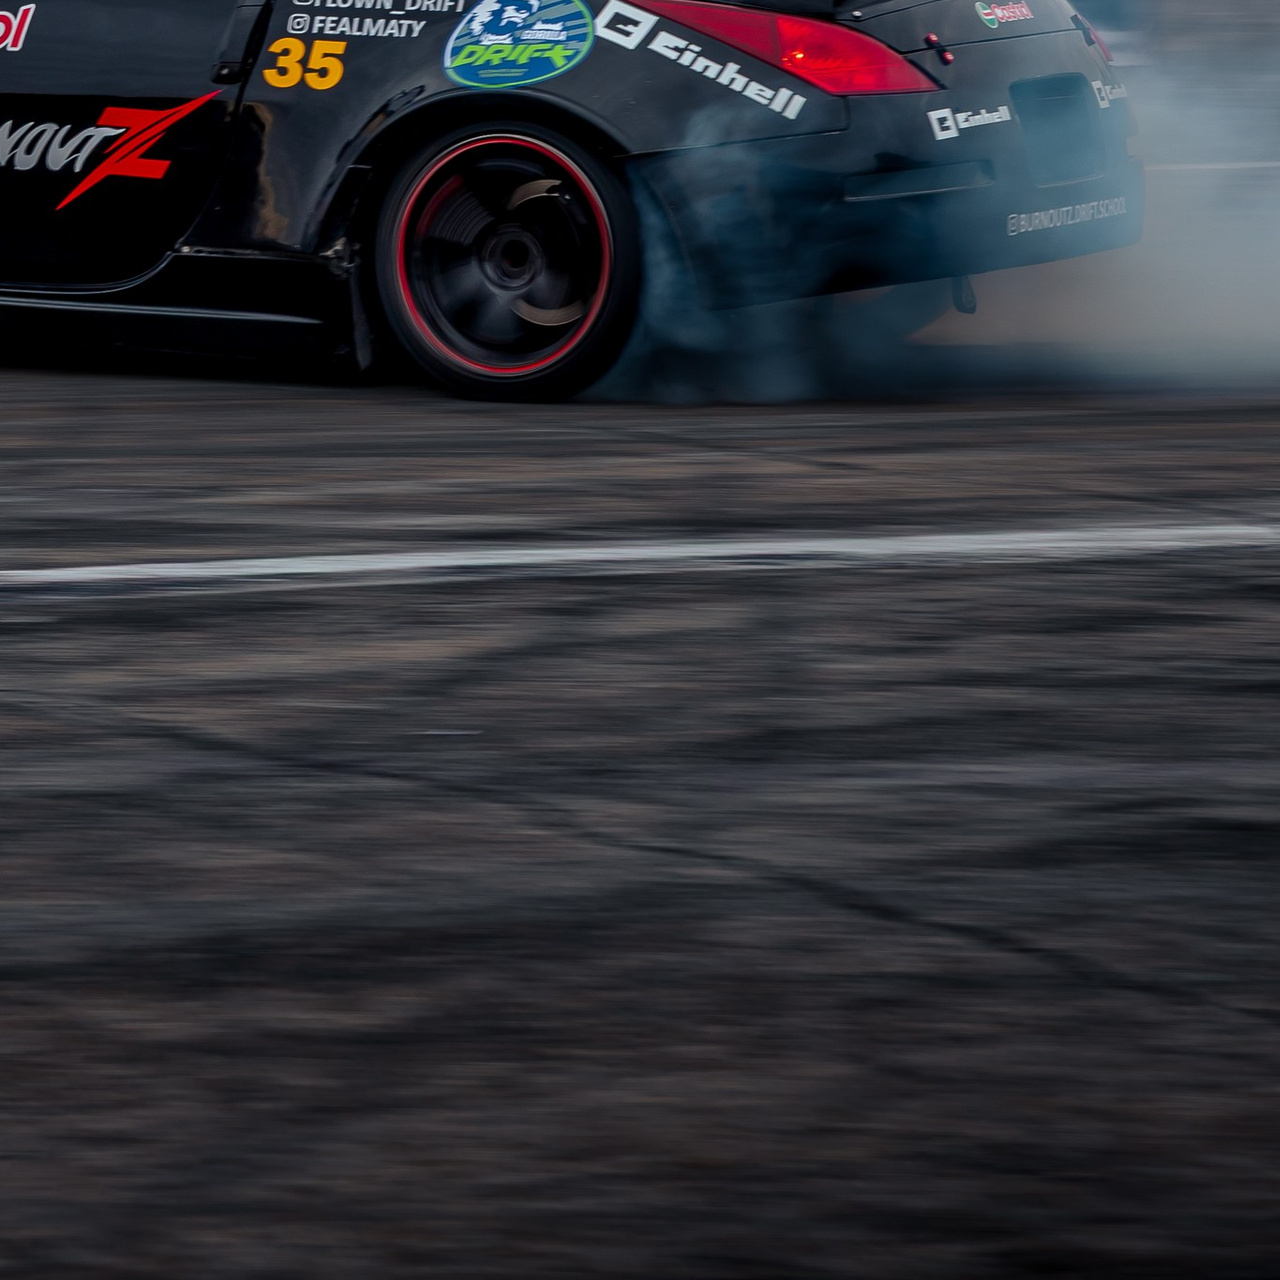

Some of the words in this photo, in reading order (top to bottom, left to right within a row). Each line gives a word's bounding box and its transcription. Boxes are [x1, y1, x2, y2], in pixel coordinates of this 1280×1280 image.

[312, 15, 426, 38] FEALMATY
[262, 37, 347, 90] 35
[648, 31, 806, 120] Einhell
